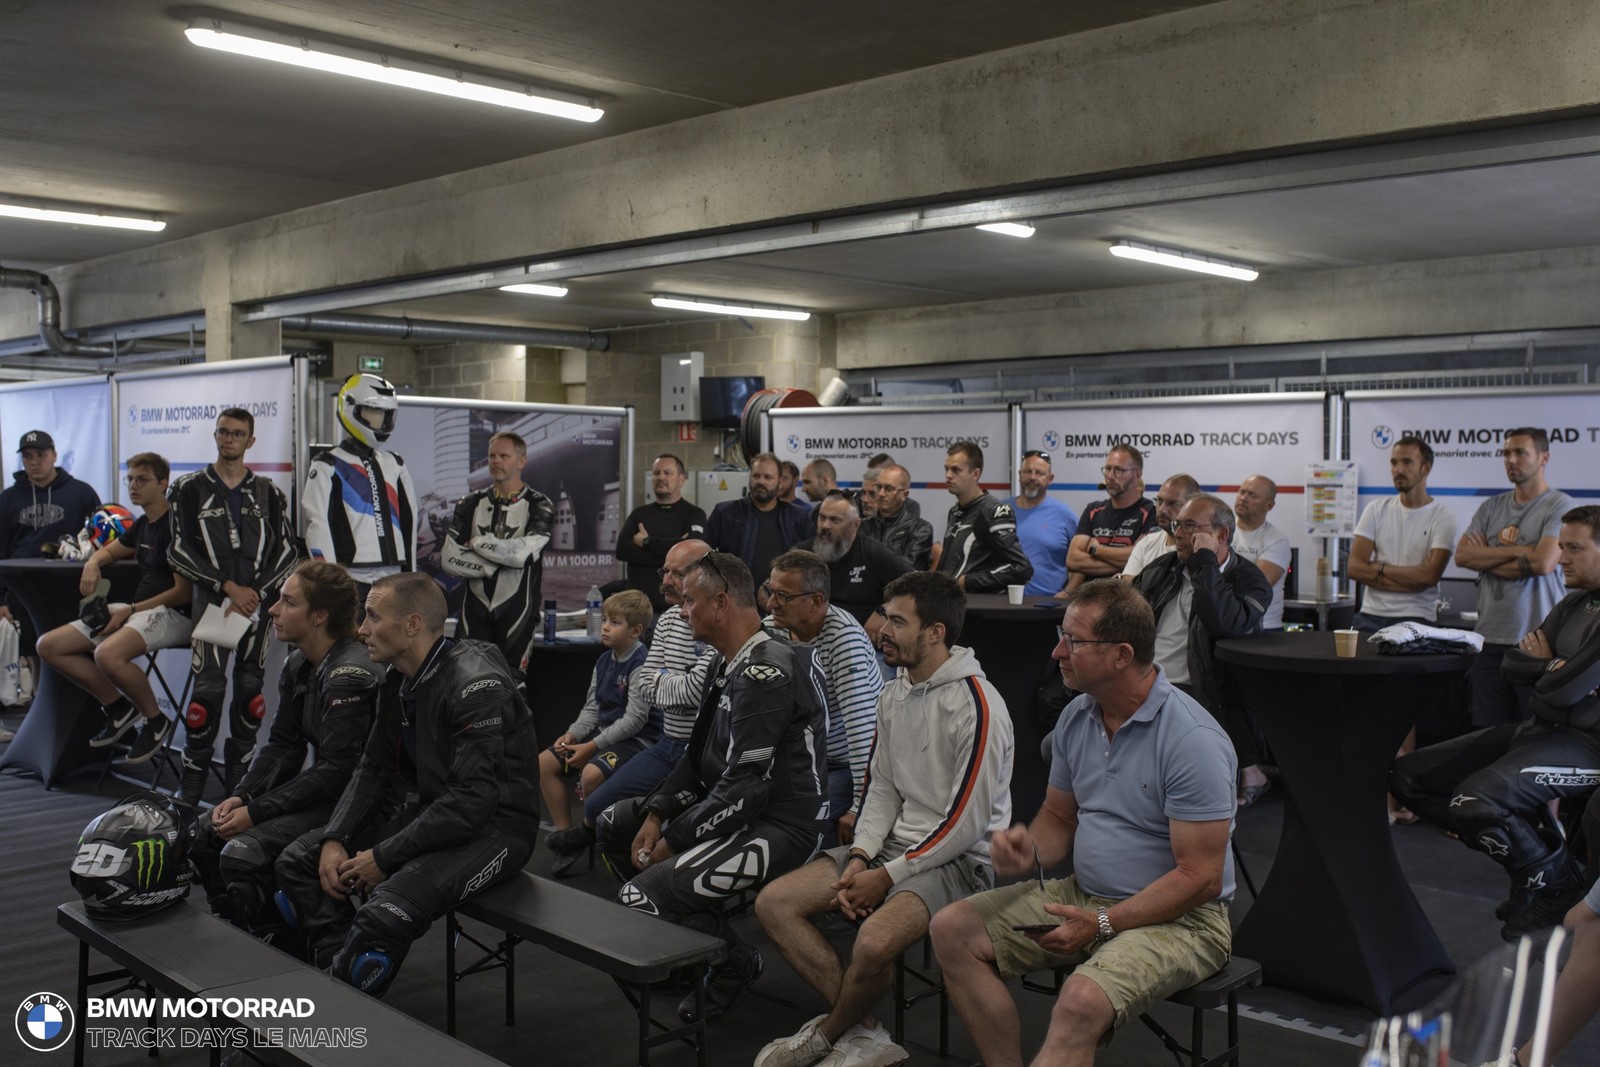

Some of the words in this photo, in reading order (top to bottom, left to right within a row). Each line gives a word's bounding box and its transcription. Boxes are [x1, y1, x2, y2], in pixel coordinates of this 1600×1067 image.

[141, 407, 163, 422] BMW
[165, 405, 217, 421] MOTORRAD
[252, 401, 278, 418] DAYS
[805, 438, 835, 449] BMW
[838, 437, 907, 449] MOTORRAD
[911, 437, 953, 449] TRACK
[1065, 434, 1102, 446] BMW
[1107, 433, 1194, 446] MOTORRAD
[1200, 432, 1253, 446] TRACK
[1257, 431, 1299, 445] DAYS
[374, 512, 386, 537] BMW
[448, 556, 483, 571] DAINESE
[557, 556, 567, 567] M
[569, 555, 597, 567] 1000
[598, 554, 613, 566] RR
[461, 679, 502, 698] RST
[71, 842, 128, 878] 20
[459, 847, 508, 900] RST
[379, 901, 413, 923] RST
